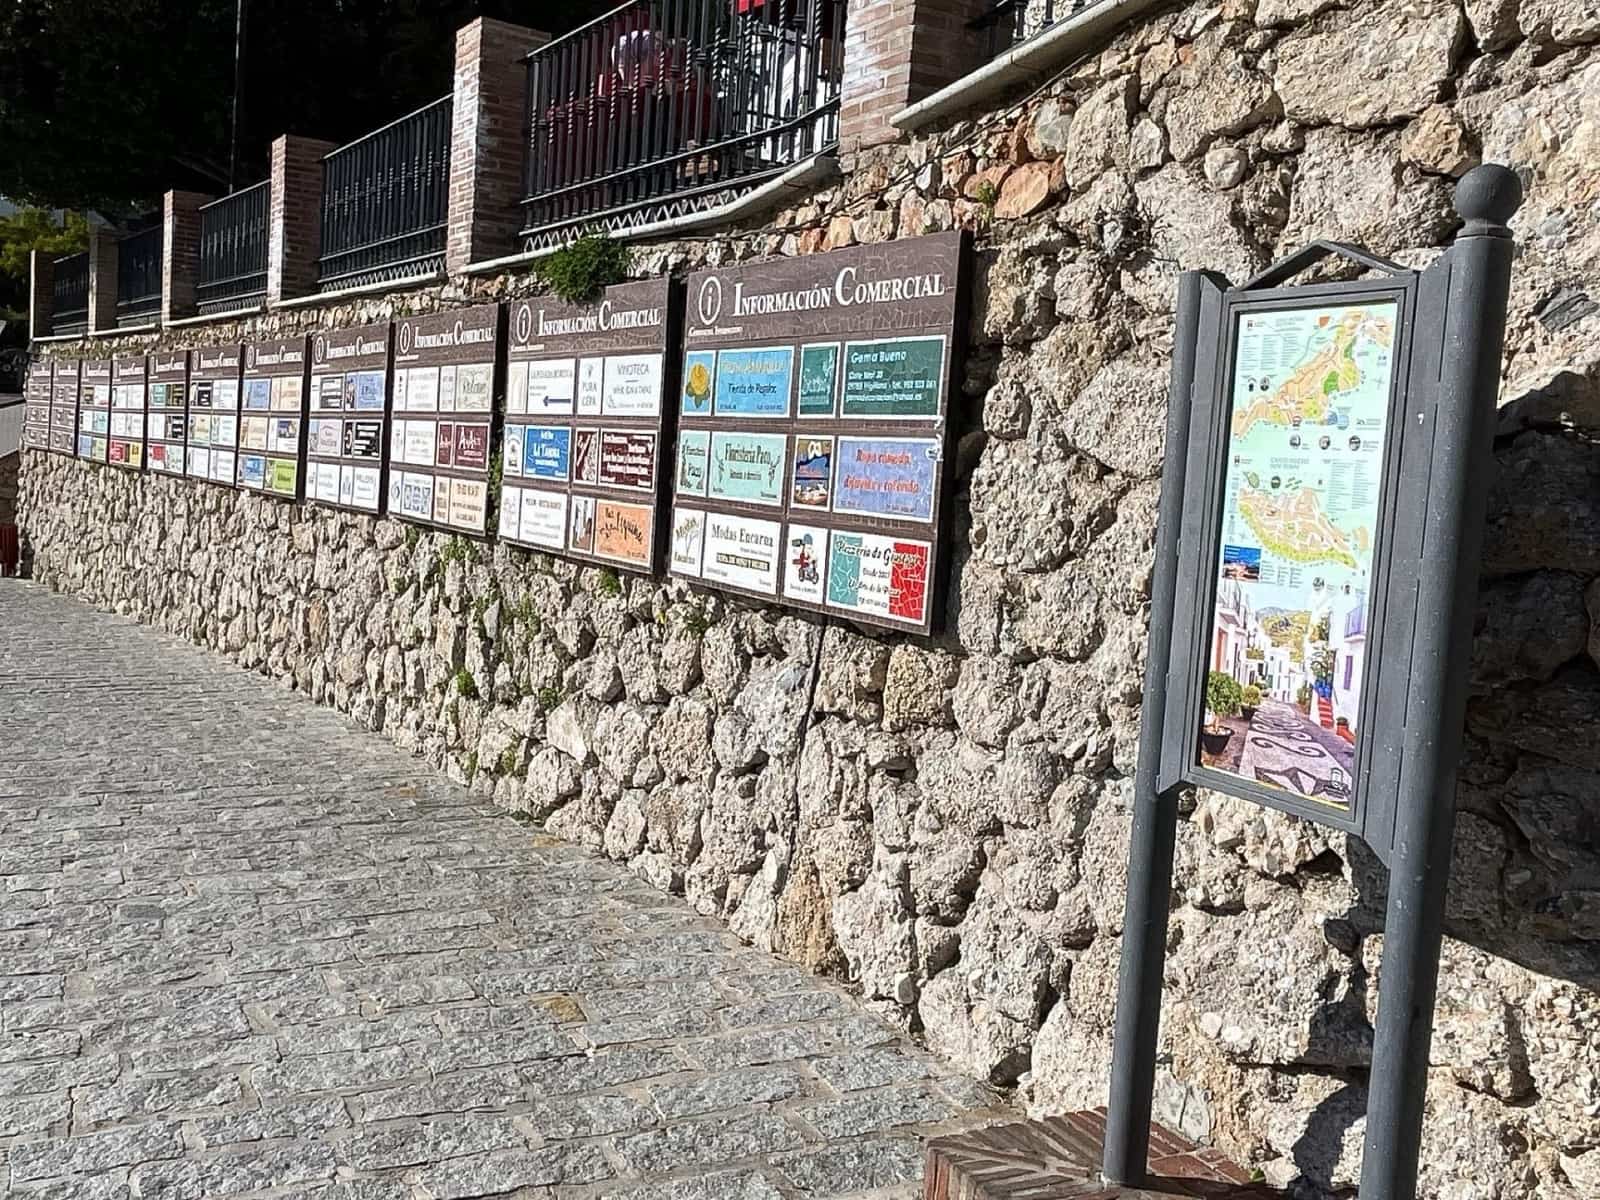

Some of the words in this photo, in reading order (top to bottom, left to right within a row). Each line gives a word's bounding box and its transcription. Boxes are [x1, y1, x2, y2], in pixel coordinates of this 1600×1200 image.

[732, 283, 834, 317] INFORMACIÓN
[835, 266, 945, 306] COMERCIAL
[711, 523, 737, 541] Modas
[739, 528, 774, 547] Encarna
